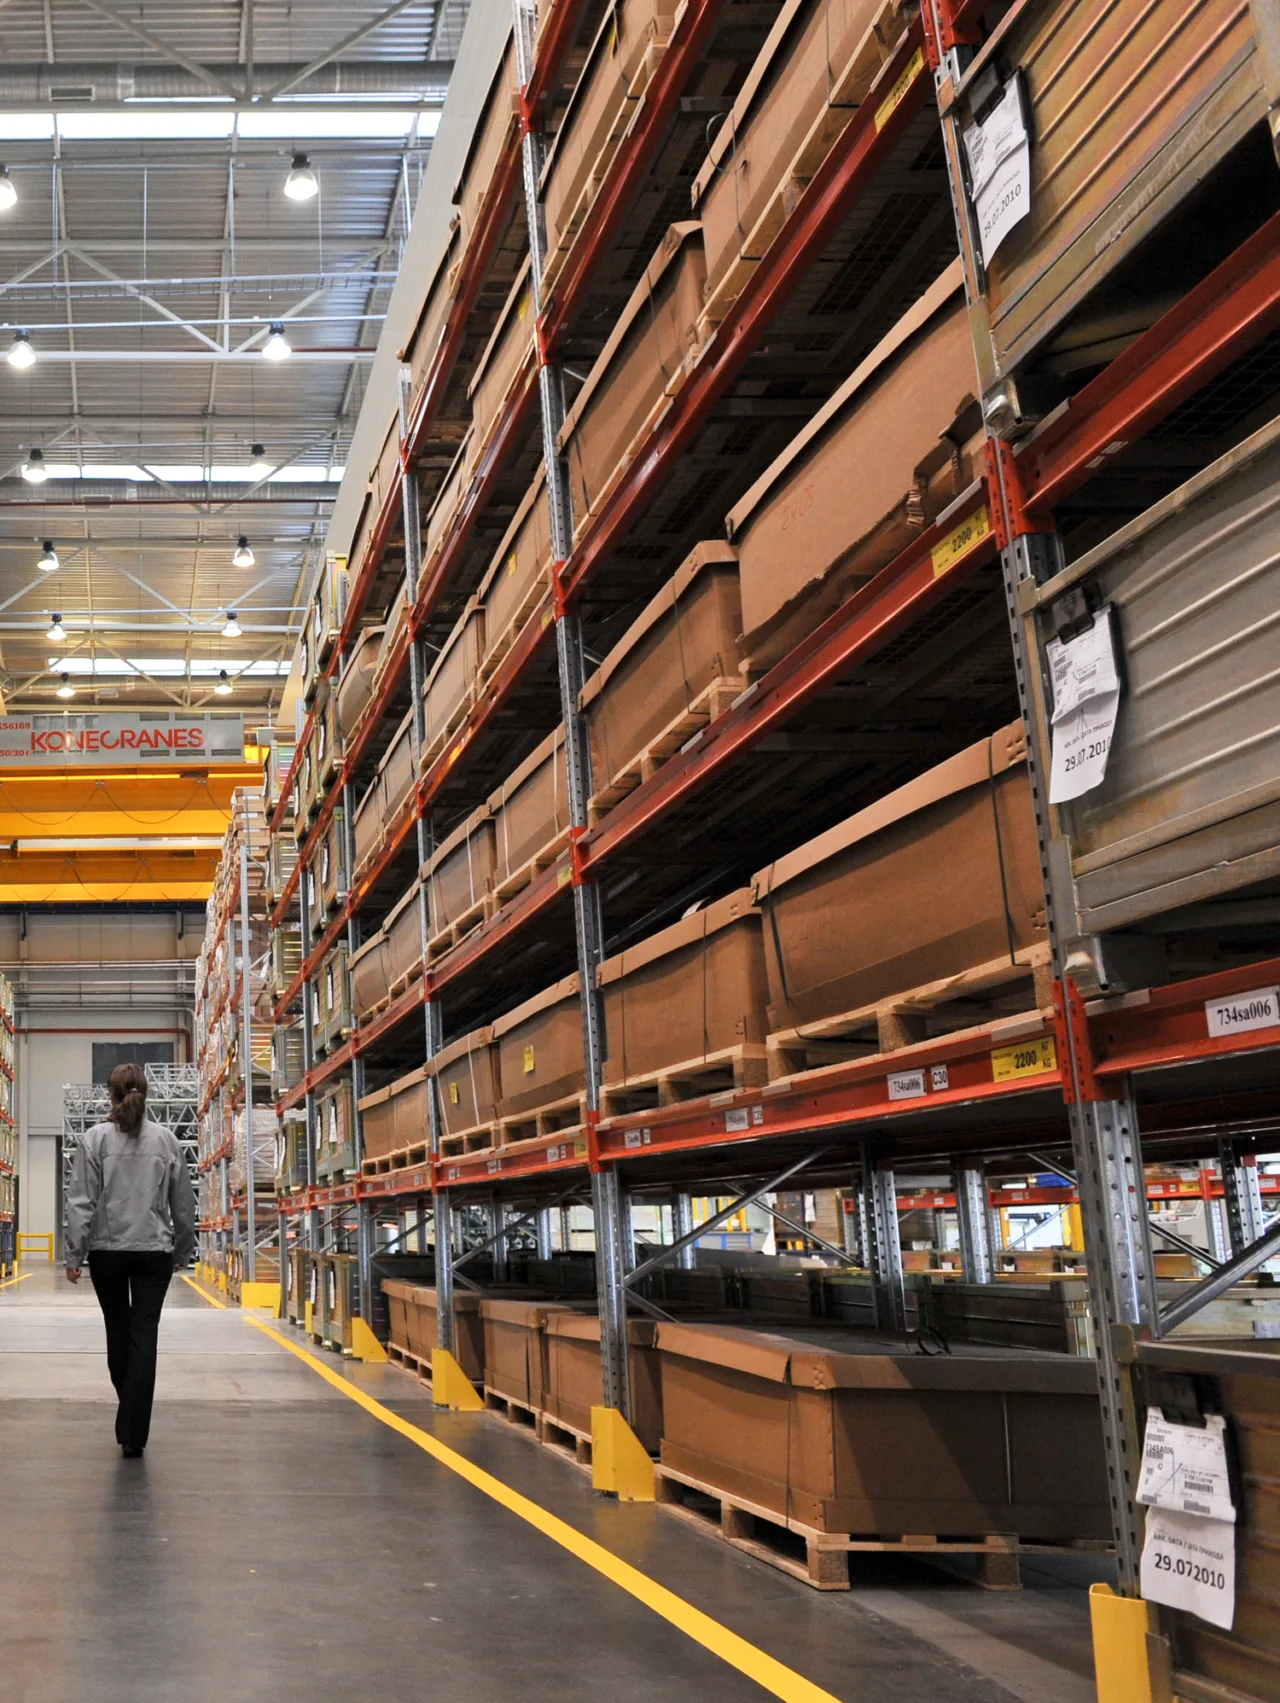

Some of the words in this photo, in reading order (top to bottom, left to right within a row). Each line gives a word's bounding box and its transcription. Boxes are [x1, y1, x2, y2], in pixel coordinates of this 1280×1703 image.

[952, 527, 972, 553] 2200
[31, 728, 204, 751] KONECRANES
[1217, 999, 1271, 1026] 734sa006
[1015, 1050, 1037, 1069] 2200
[932, 1070, 947, 1085] C30
